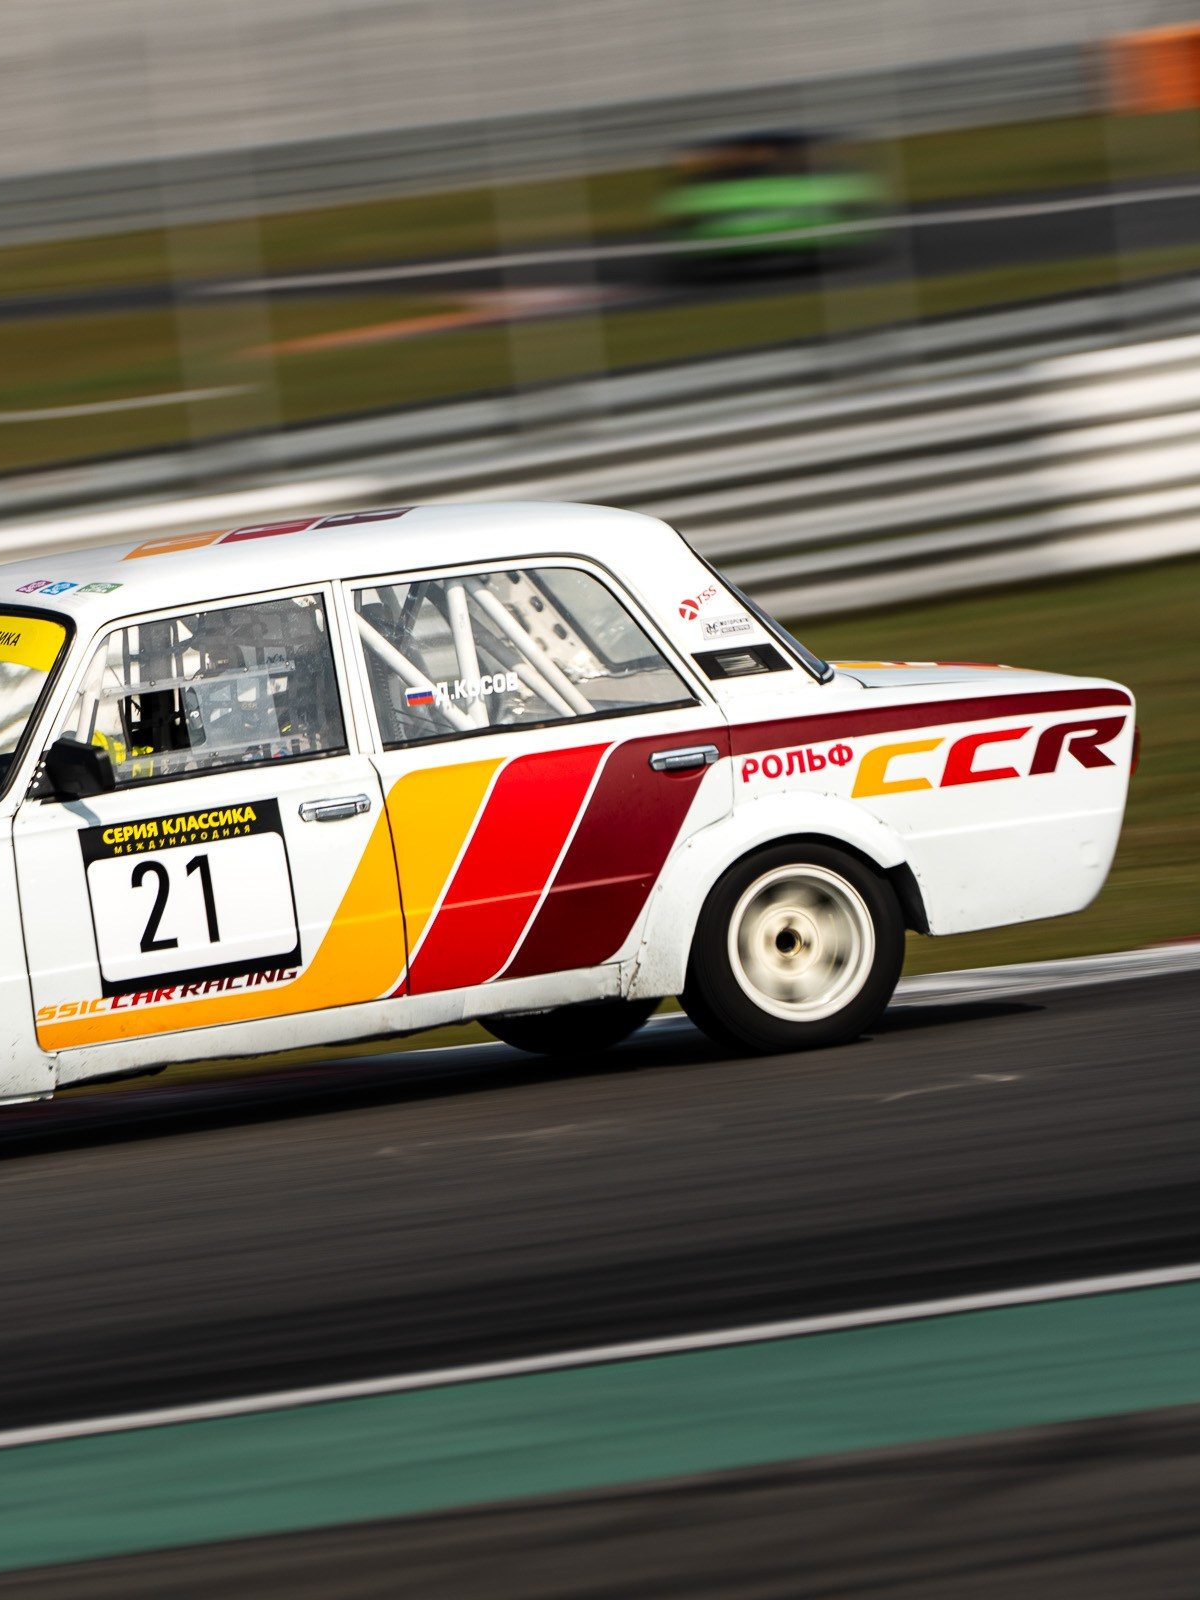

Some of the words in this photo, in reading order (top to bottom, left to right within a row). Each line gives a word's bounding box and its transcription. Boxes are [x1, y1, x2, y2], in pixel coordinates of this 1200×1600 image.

[696, 585, 717, 605] TSS
[741, 743, 854, 784] РОЛЬФ
[851, 714, 1128, 799] CCR
[102, 820, 159, 845] СЕРИЯ
[162, 806, 257, 836] КЛАССИКА
[114, 824, 251, 855] МЕЖДУНАРОДНАЯ
[130, 853, 221, 954] 21
[179, 969, 298, 998] RACING
